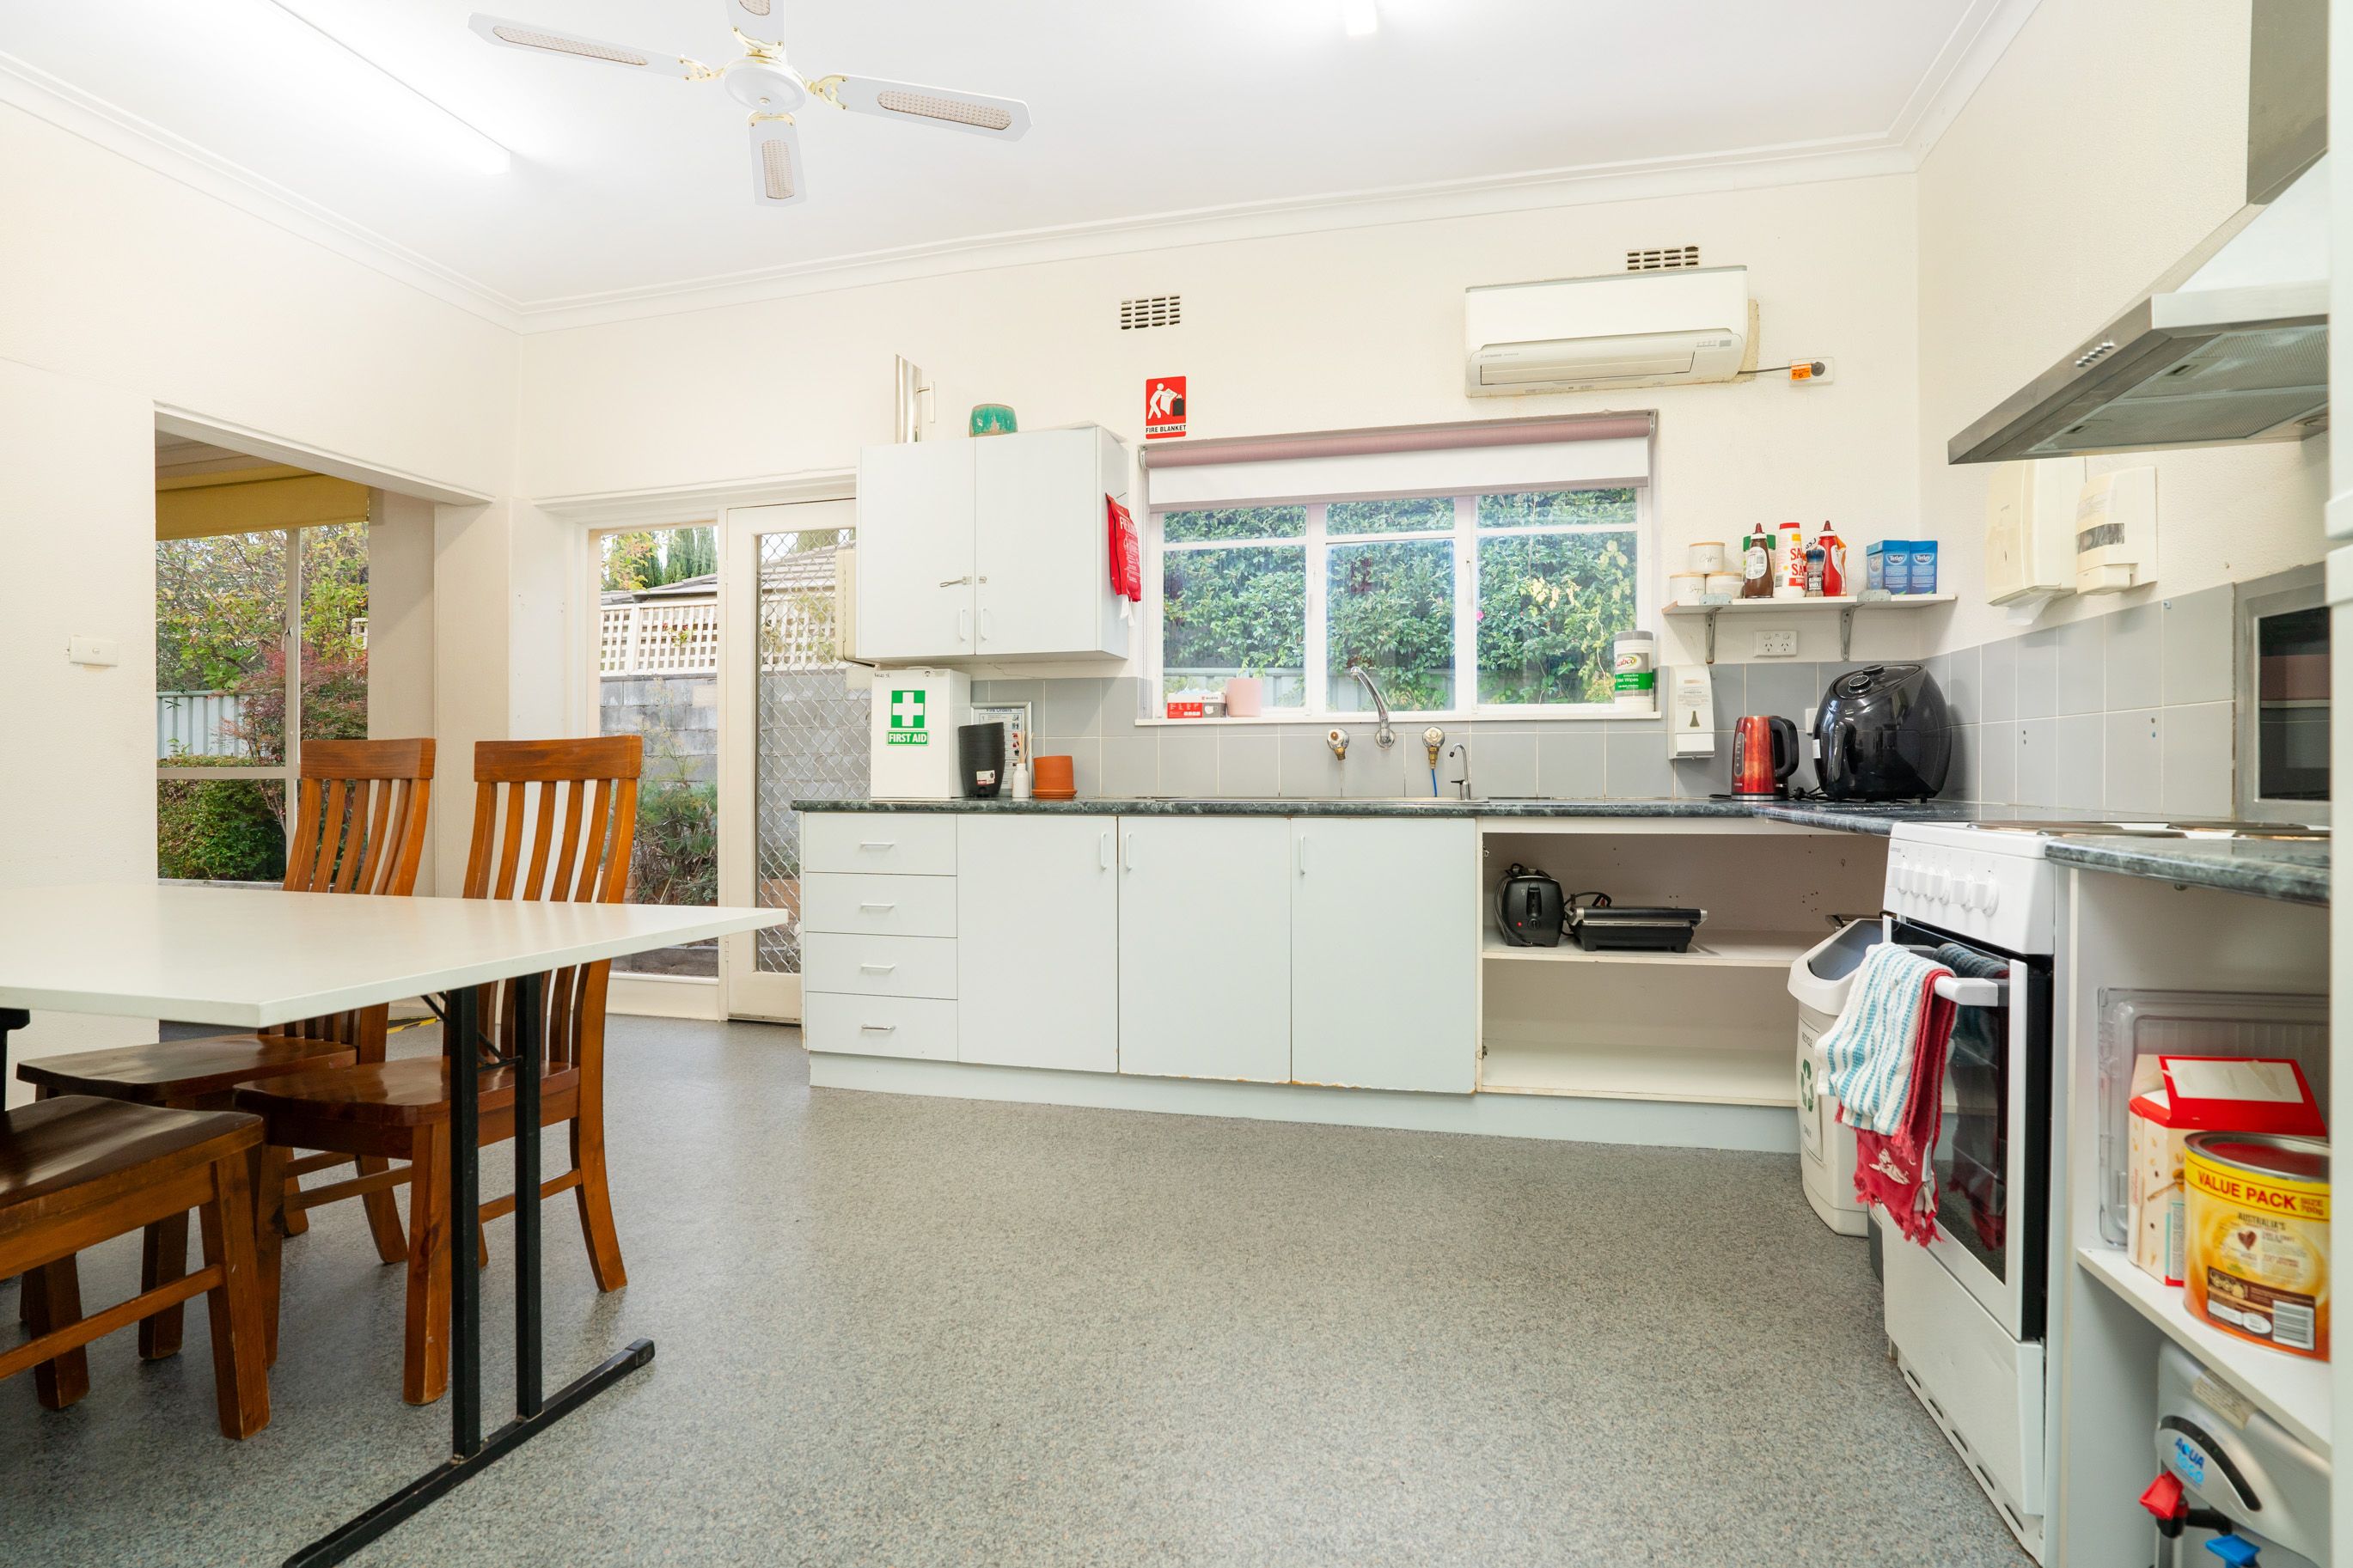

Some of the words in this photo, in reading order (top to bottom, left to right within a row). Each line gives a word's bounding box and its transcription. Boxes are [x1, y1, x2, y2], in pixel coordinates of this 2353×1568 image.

[1790, 547, 1803, 561] SA
[1792, 564, 1804, 577] SA
[889, 734, 912, 742] FIRST
[912, 734, 927, 742] AID
[2198, 1170, 2241, 1198] VALUE
[2246, 1187, 2296, 1211] PACK
[2175, 1437, 2204, 1469] AQUA
